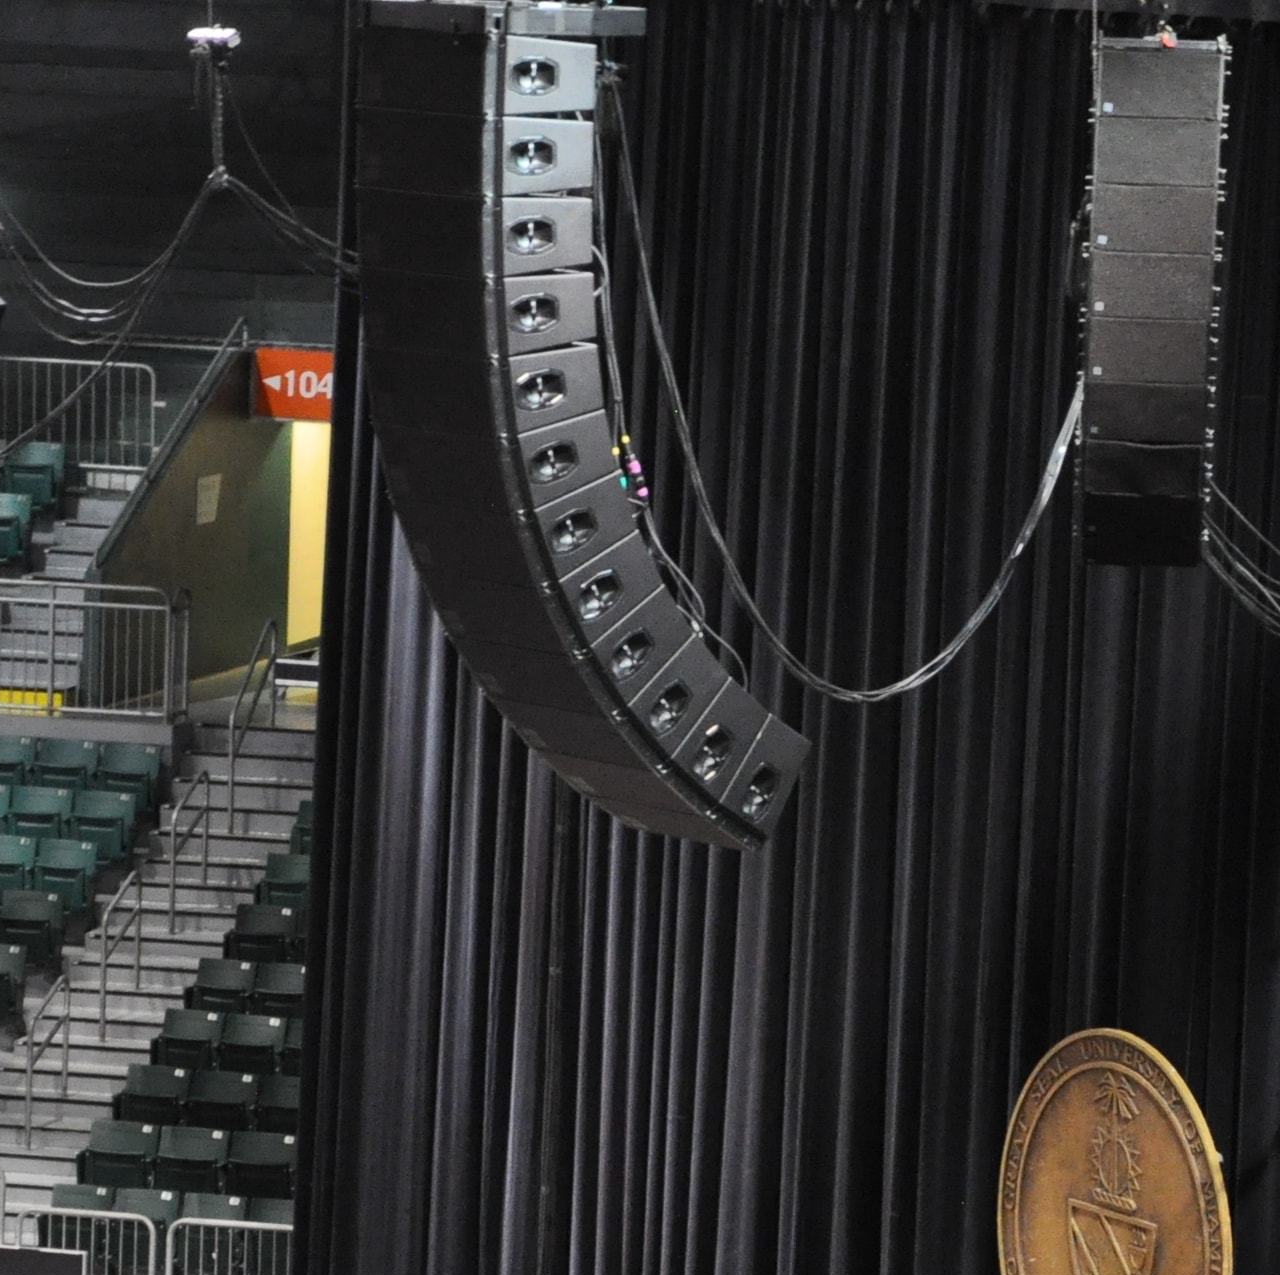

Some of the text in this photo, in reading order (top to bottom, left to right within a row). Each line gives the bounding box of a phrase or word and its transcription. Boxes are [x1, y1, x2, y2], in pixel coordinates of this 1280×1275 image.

[284, 369, 333, 400] 104
[1004, 1039, 1223, 1275] GREAT SEAL UNIVERSITY OF MIAMI
